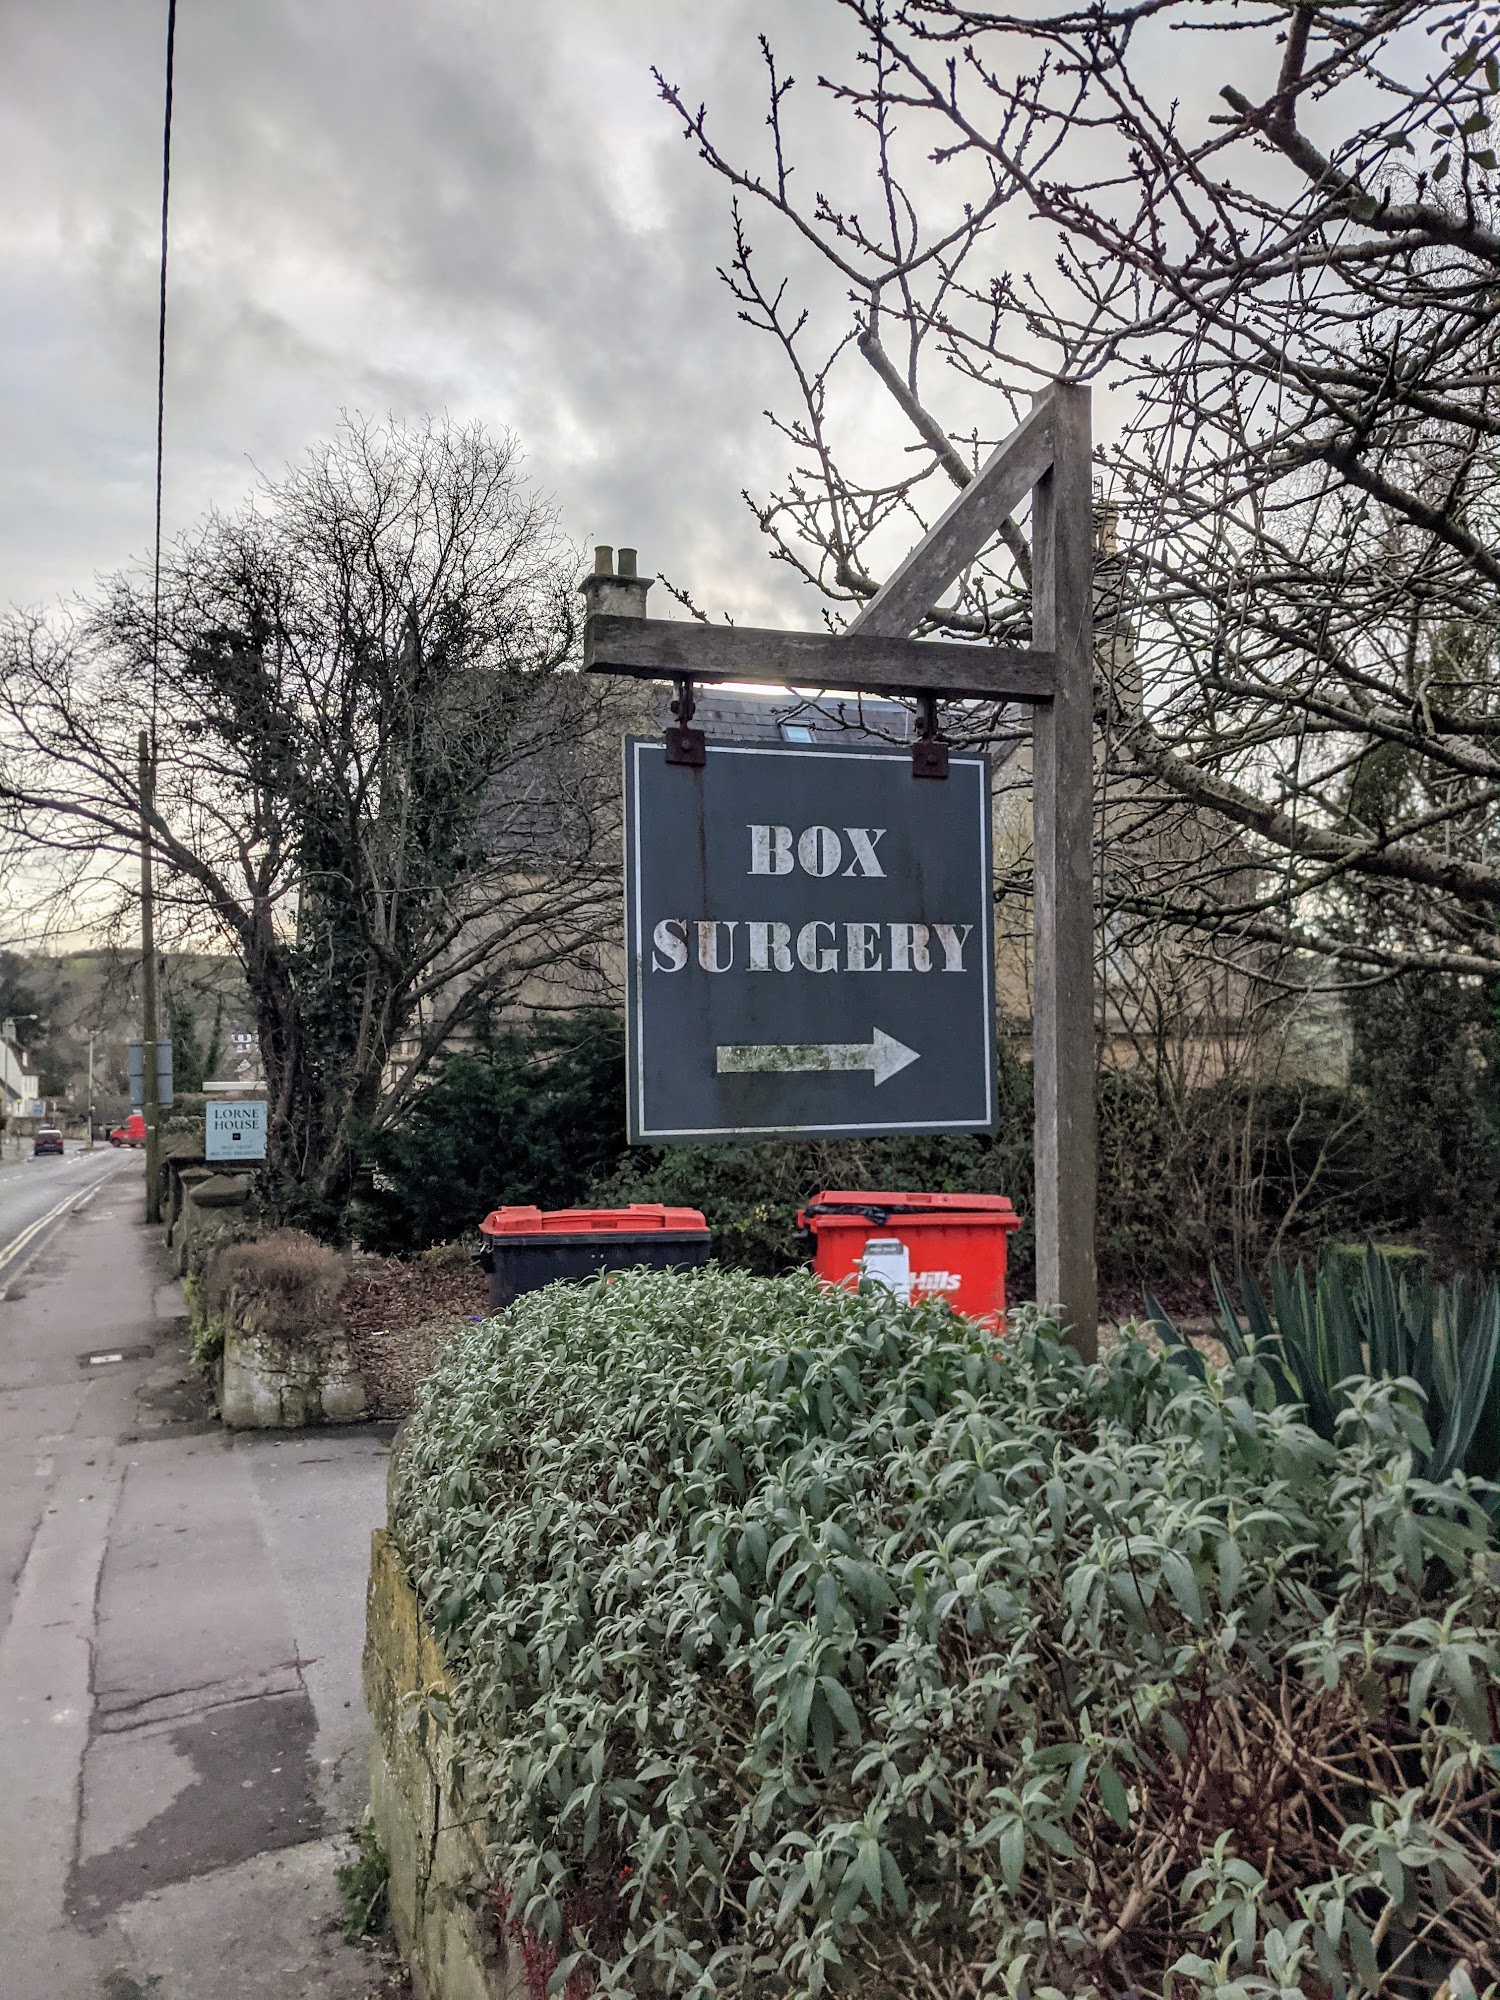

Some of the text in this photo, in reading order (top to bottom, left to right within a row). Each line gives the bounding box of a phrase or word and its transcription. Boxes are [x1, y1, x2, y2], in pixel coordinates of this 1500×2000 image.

[746, 824, 888, 878] BOX
[651, 917, 974, 974] SURGERY
[214, 1108, 260, 1119] LORNE
[214, 1119, 260, 1130] HOUSE
[910, 1270, 962, 1290] Hills
